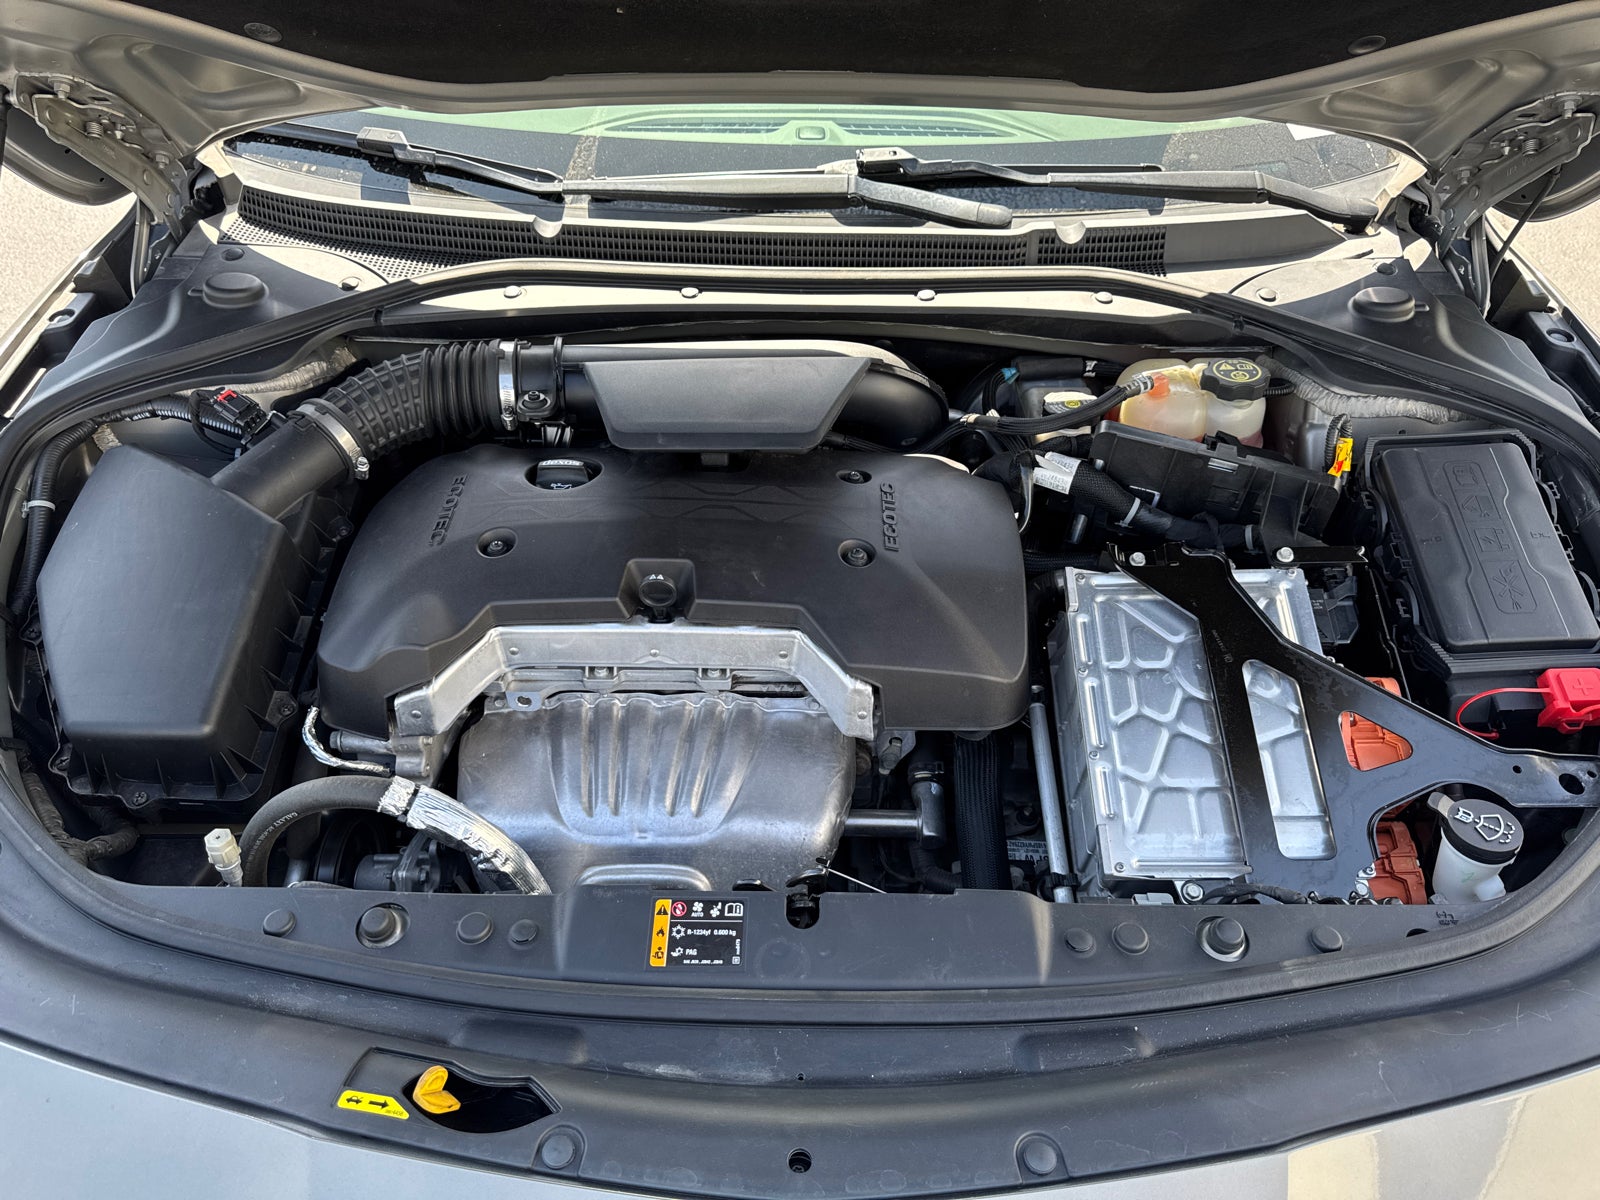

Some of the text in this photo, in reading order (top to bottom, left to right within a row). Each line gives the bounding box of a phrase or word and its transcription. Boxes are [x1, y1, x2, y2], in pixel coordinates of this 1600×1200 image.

[428, 474, 467, 547] ECOTEC
[880, 480, 899, 552] ECOTEC
[687, 929, 711, 937] R-1234yf
[729, 929, 736, 937] kg
